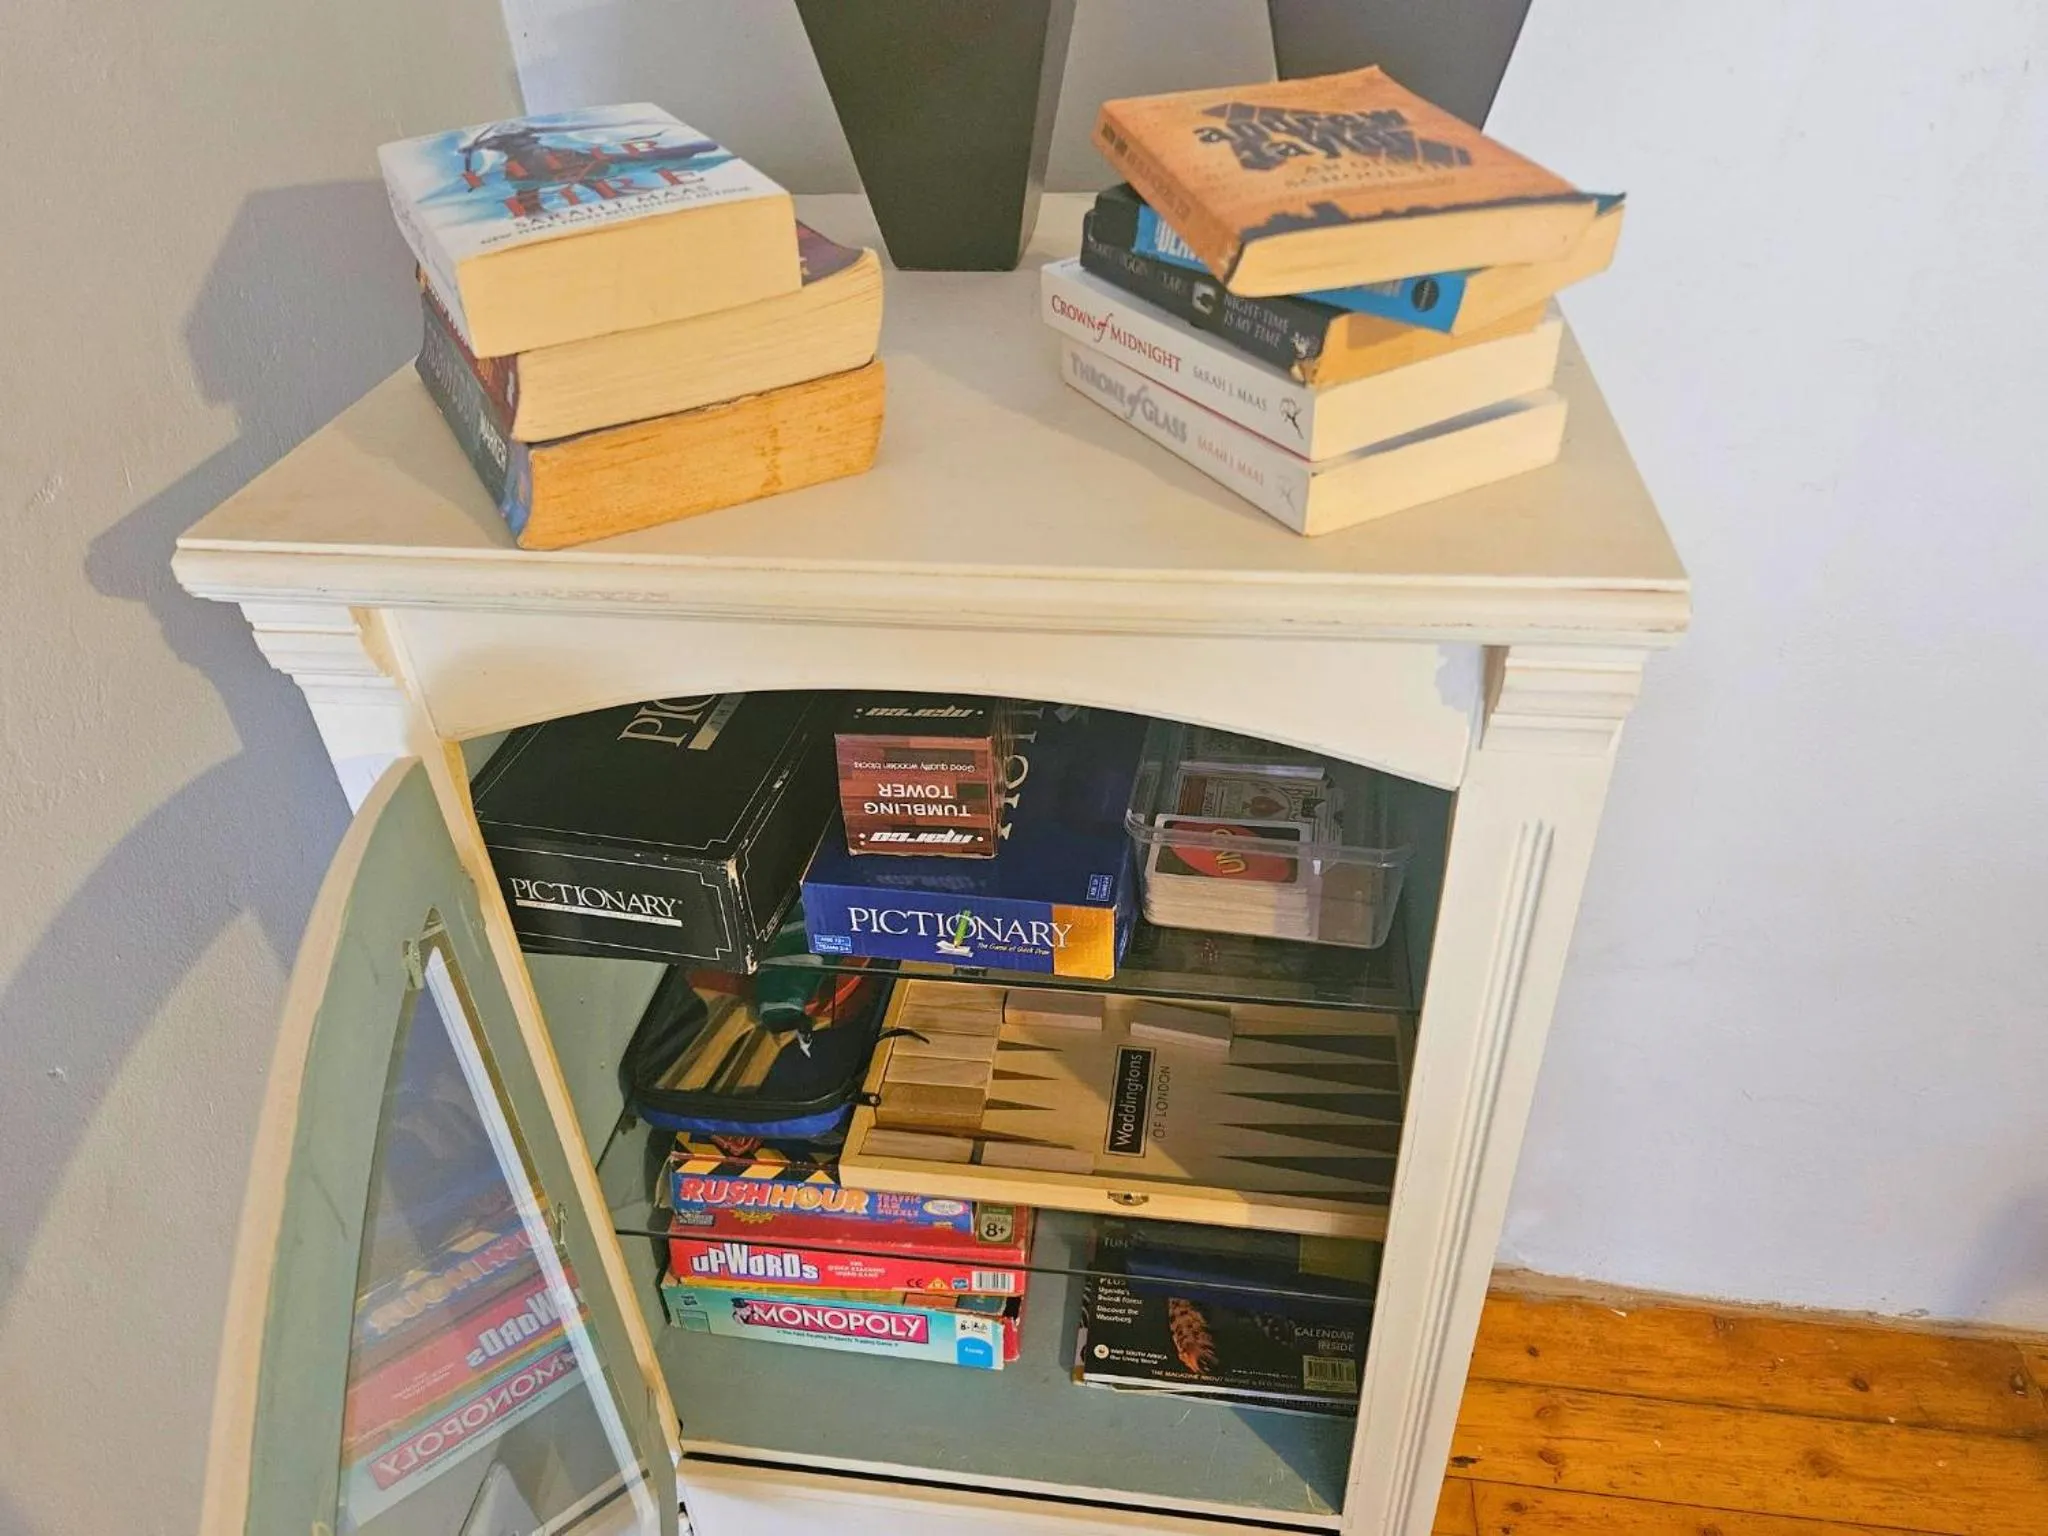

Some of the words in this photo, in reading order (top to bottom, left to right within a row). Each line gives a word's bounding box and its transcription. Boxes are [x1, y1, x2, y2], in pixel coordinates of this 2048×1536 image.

[1051, 294, 1098, 330] CROWN
[1110, 325, 1183, 373] MIDNIGHT
[1070, 352, 1126, 404] THRONE
[1141, 398, 1188, 444] GLASS
[1237, 387, 1268, 412] MAAS
[950, 764, 975, 773] Good
[878, 783, 954, 799] TOWER
[864, 802, 971, 817] TUMBLING
[510, 878, 676, 918] PICTIONARY
[847, 906, 1073, 949] PICTIONARY
[1115, 1053, 1144, 1146] Waddingtons
[1155, 1065, 1172, 1118] LONDON
[1153, 1121, 1166, 1139] OF
[985, 1222, 1006, 1238] 8+
[753, 1303, 921, 1338] MONOPOLY
[1097, 1305, 1126, 1315] Discover
[1295, 1327, 1354, 1341] CALENDAR
